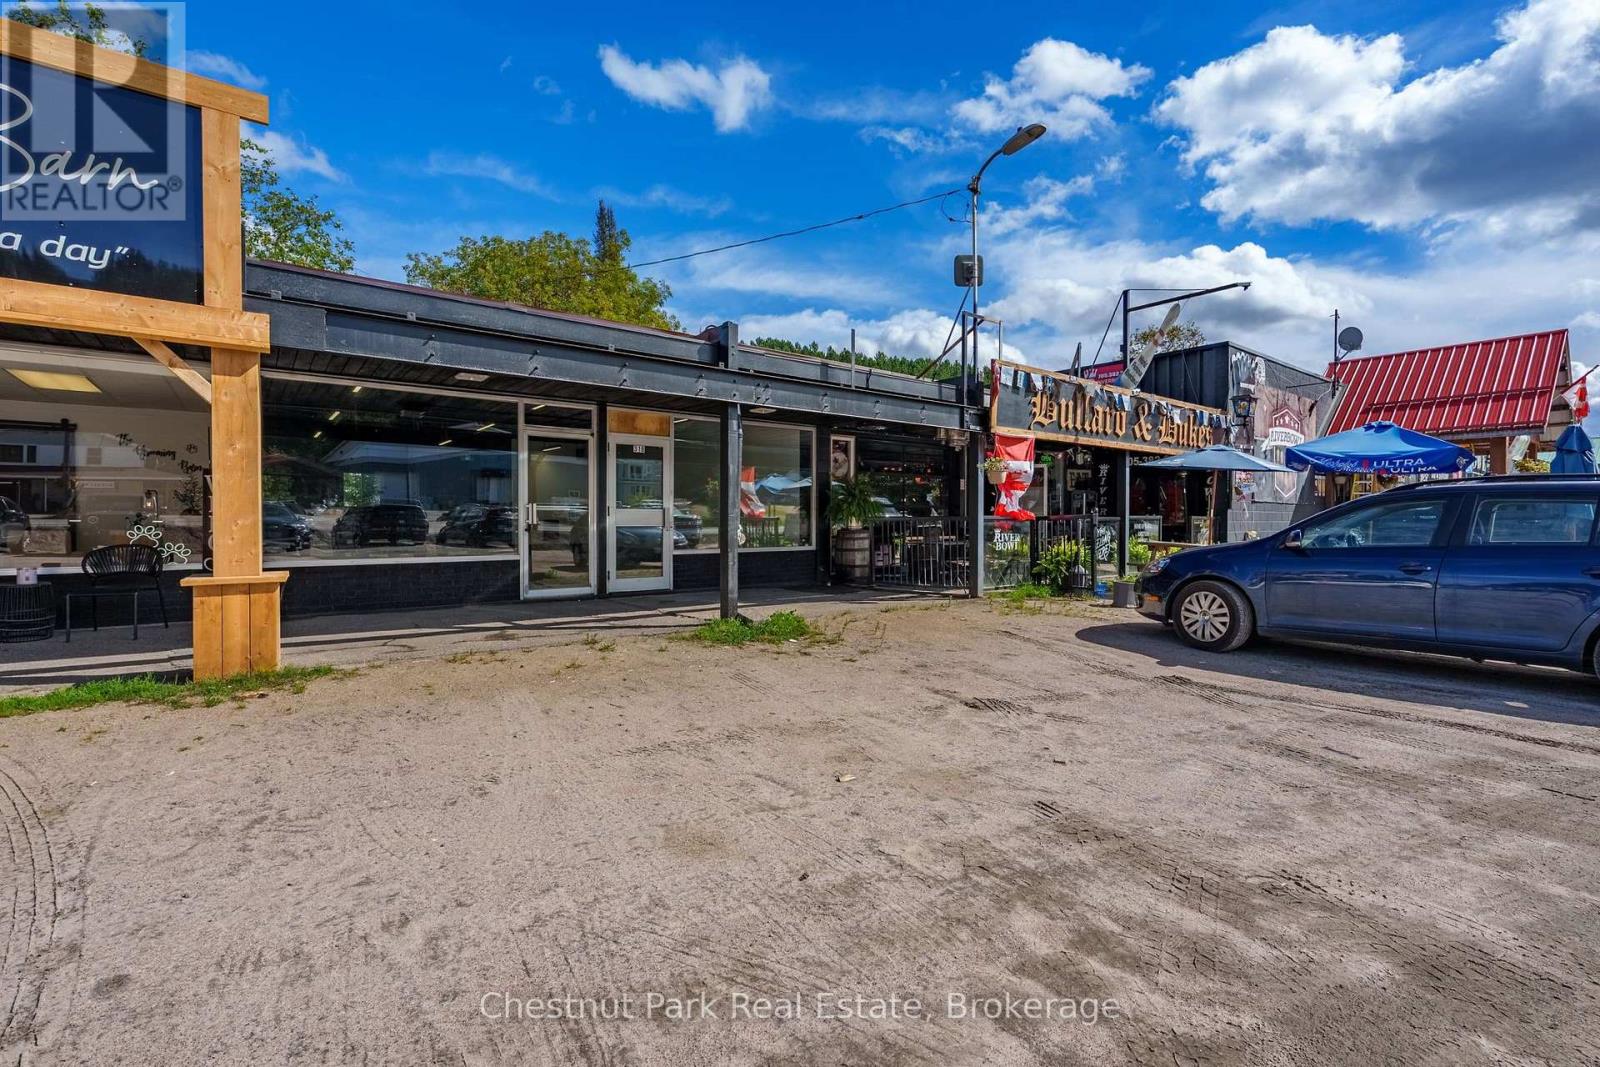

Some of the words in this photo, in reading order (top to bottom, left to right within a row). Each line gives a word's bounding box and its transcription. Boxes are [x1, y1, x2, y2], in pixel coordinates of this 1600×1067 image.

[1134, 403, 1153, 441] &
[1373, 458, 1425, 468] ULTRA
[994, 532, 1021, 542] RIVER
